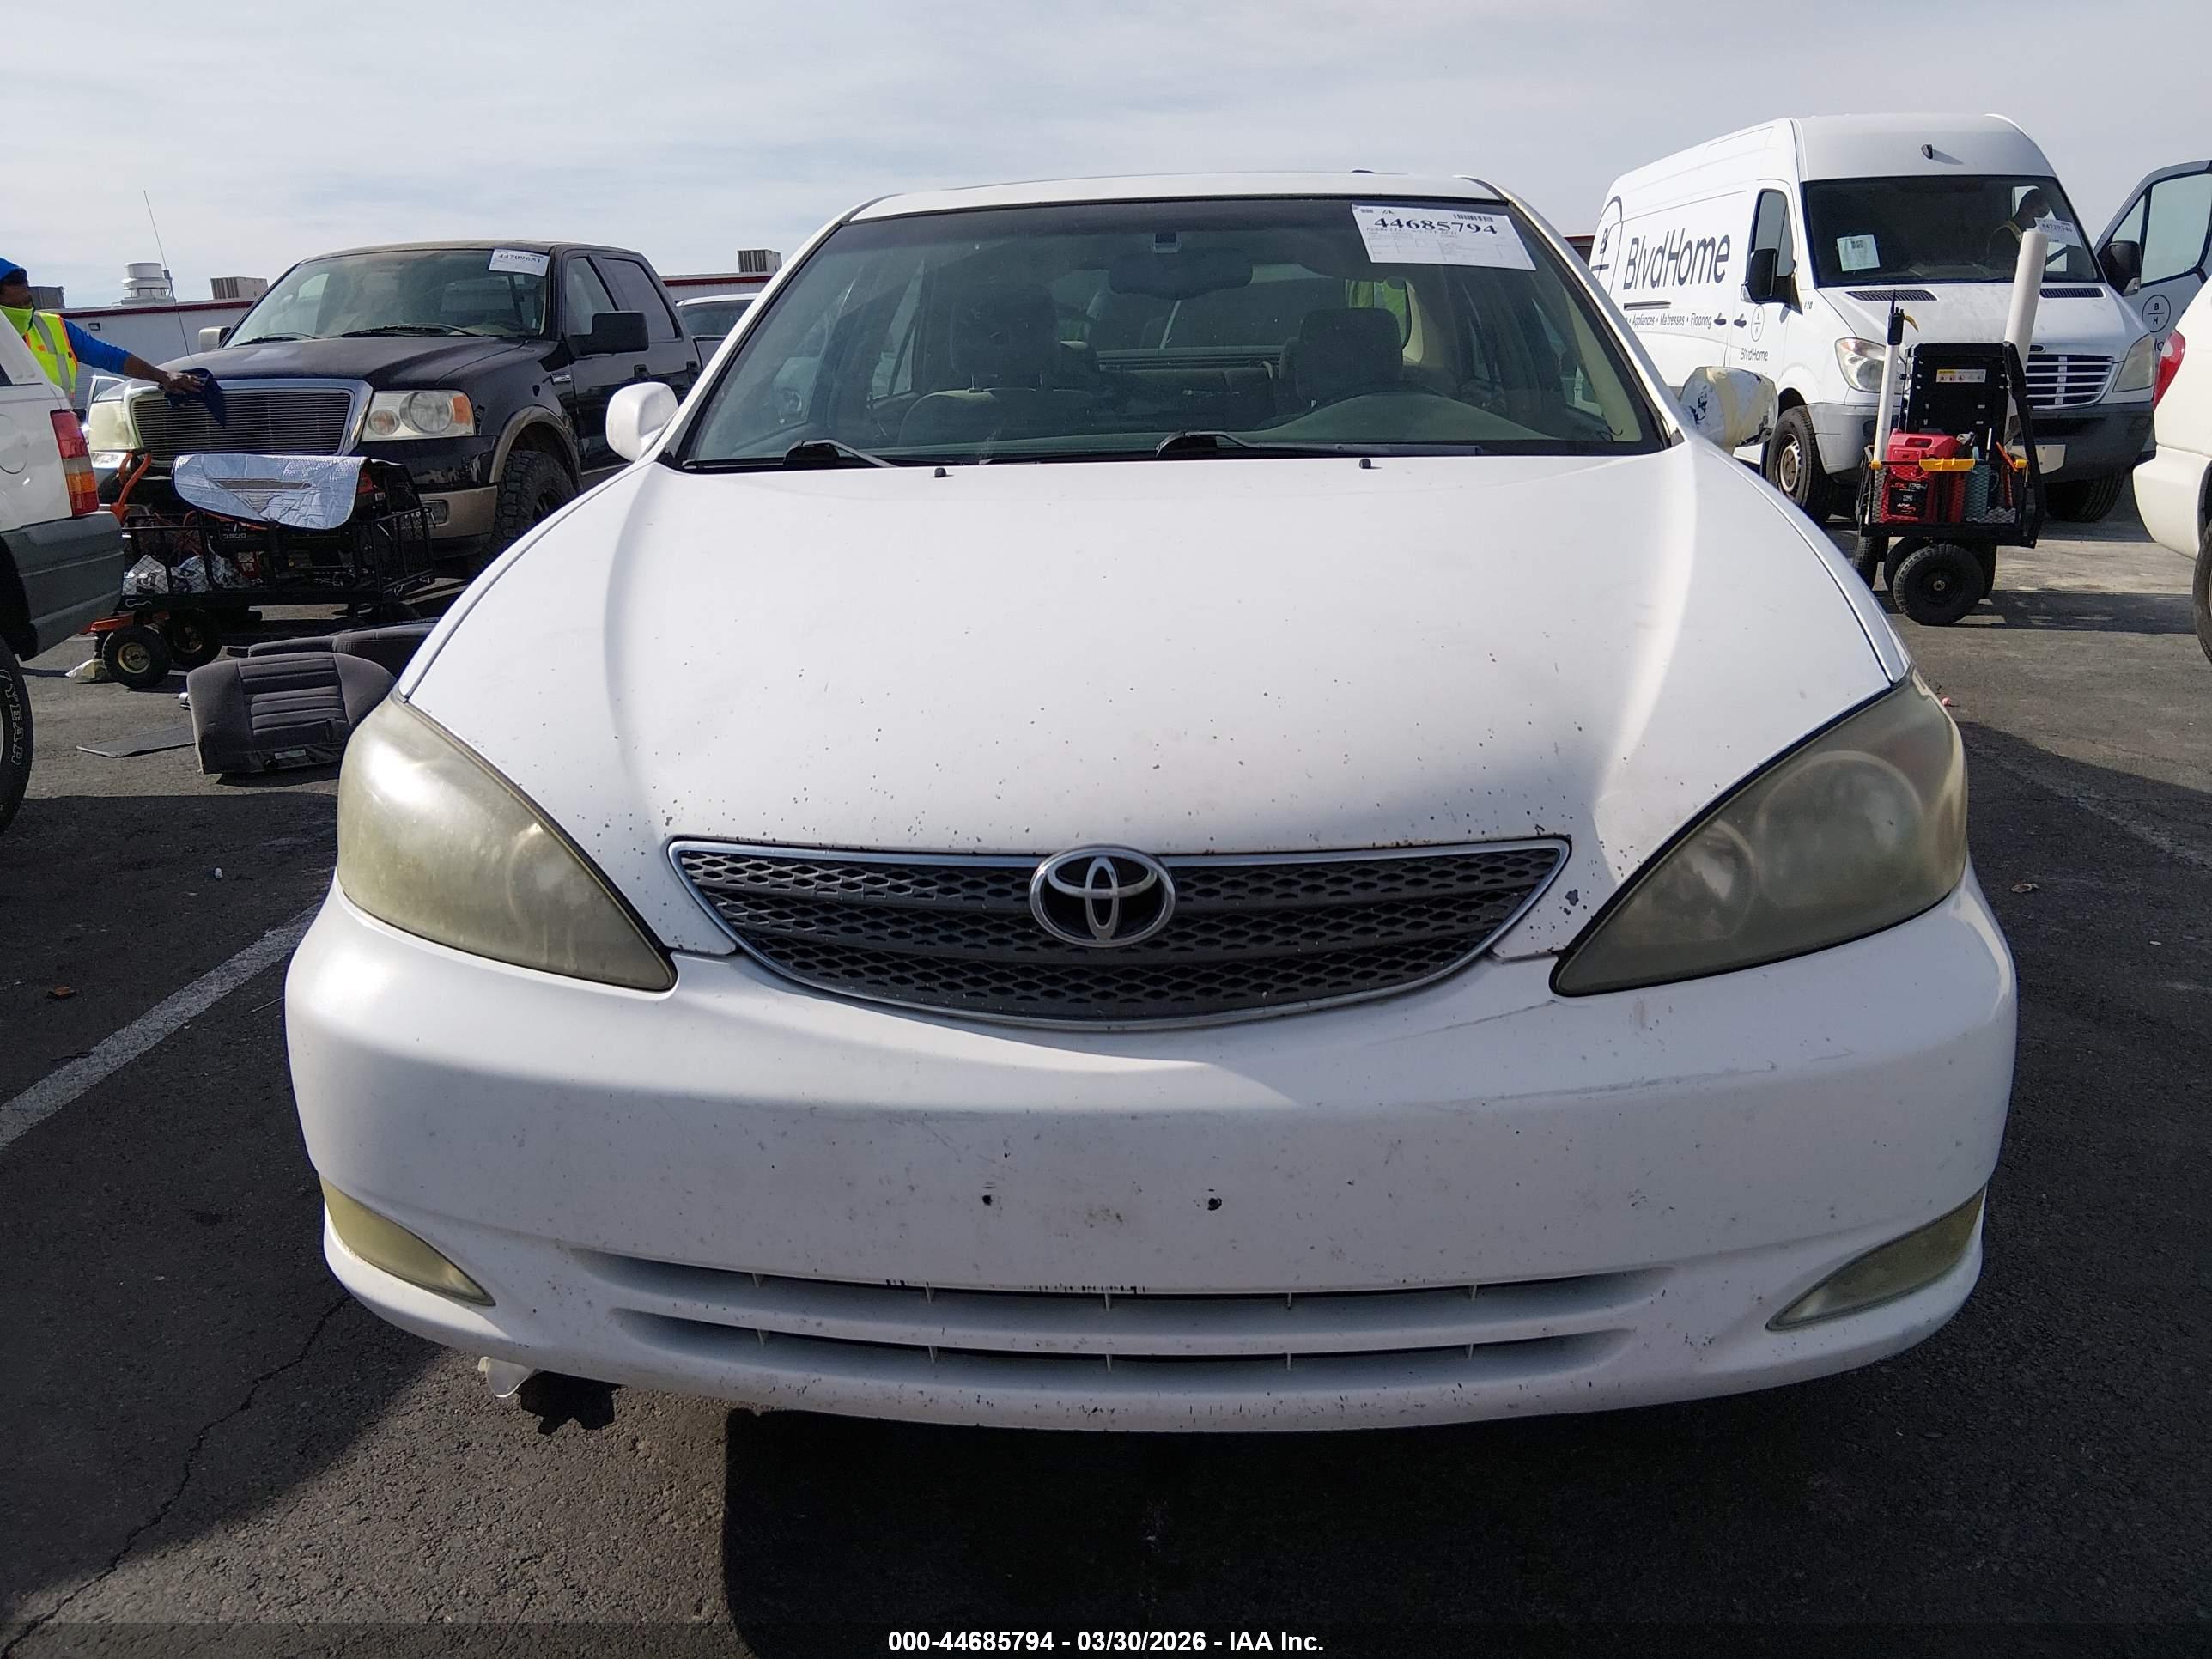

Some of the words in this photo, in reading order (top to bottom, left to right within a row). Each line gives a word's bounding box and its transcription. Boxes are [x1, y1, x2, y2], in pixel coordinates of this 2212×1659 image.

[1374, 218, 1498, 234] 44685794
[1600, 228, 1608, 254] B
[1623, 228, 1730, 290] BlvdHome
[1632, 313, 1655, 328] Appliances
[1691, 312, 1712, 330] Flooring
[1740, 347, 1769, 362] BlvdHome
